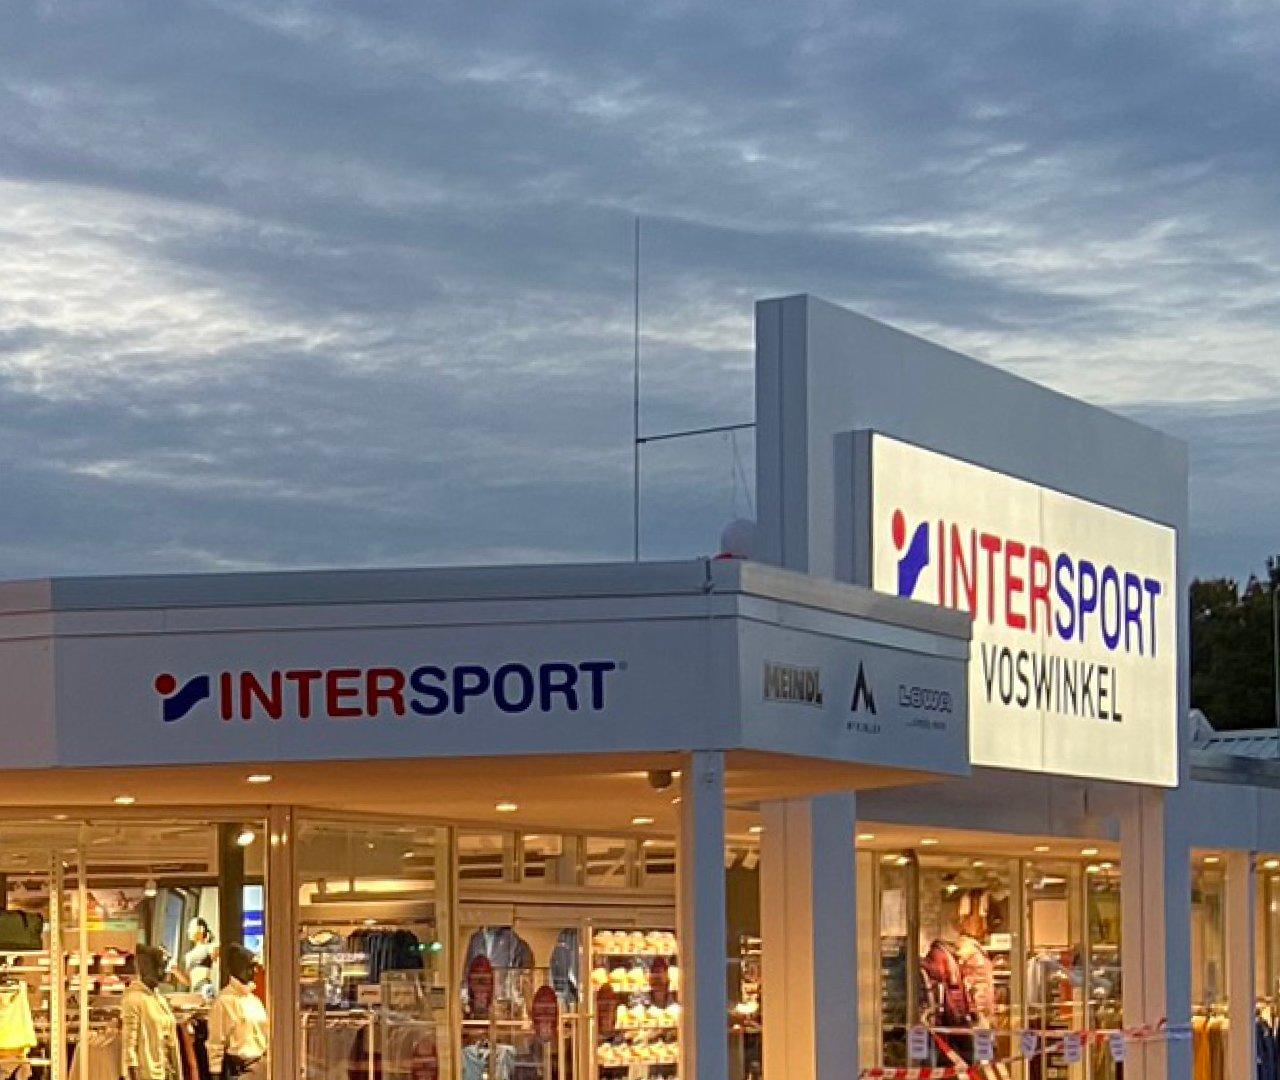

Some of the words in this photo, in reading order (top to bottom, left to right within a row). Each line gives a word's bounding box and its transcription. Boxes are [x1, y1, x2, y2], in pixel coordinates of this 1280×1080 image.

[936, 518, 1163, 659] INTERSPORT
[219, 660, 616, 720] INTERSPORT
[980, 641, 1123, 723] VOSWINKEL
